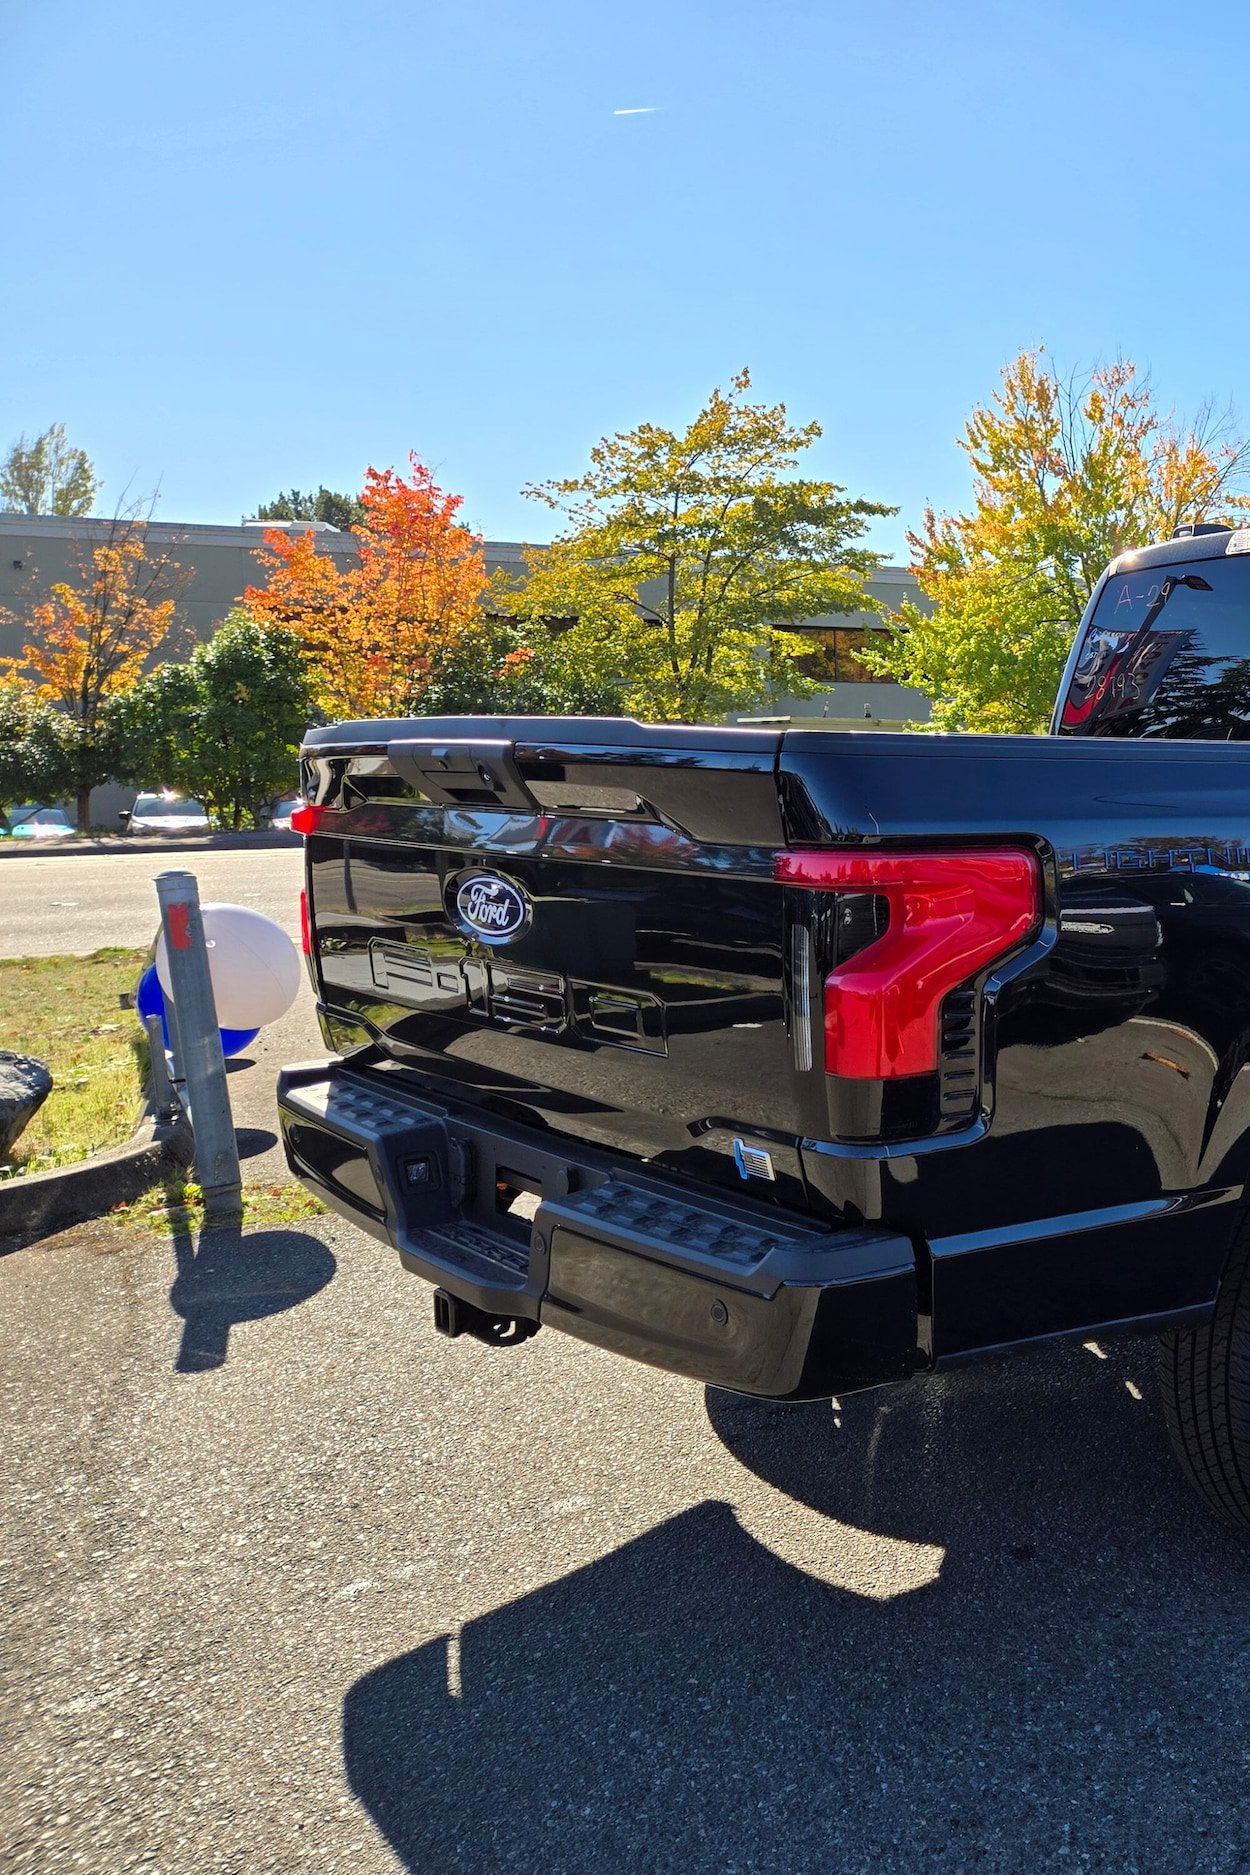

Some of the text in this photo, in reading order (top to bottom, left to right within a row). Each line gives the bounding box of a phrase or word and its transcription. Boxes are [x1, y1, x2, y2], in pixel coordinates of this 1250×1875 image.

[1113, 581, 1171, 615] A-29
[467, 883, 510, 927] Ford
[366, 935, 670, 1059] F-150
